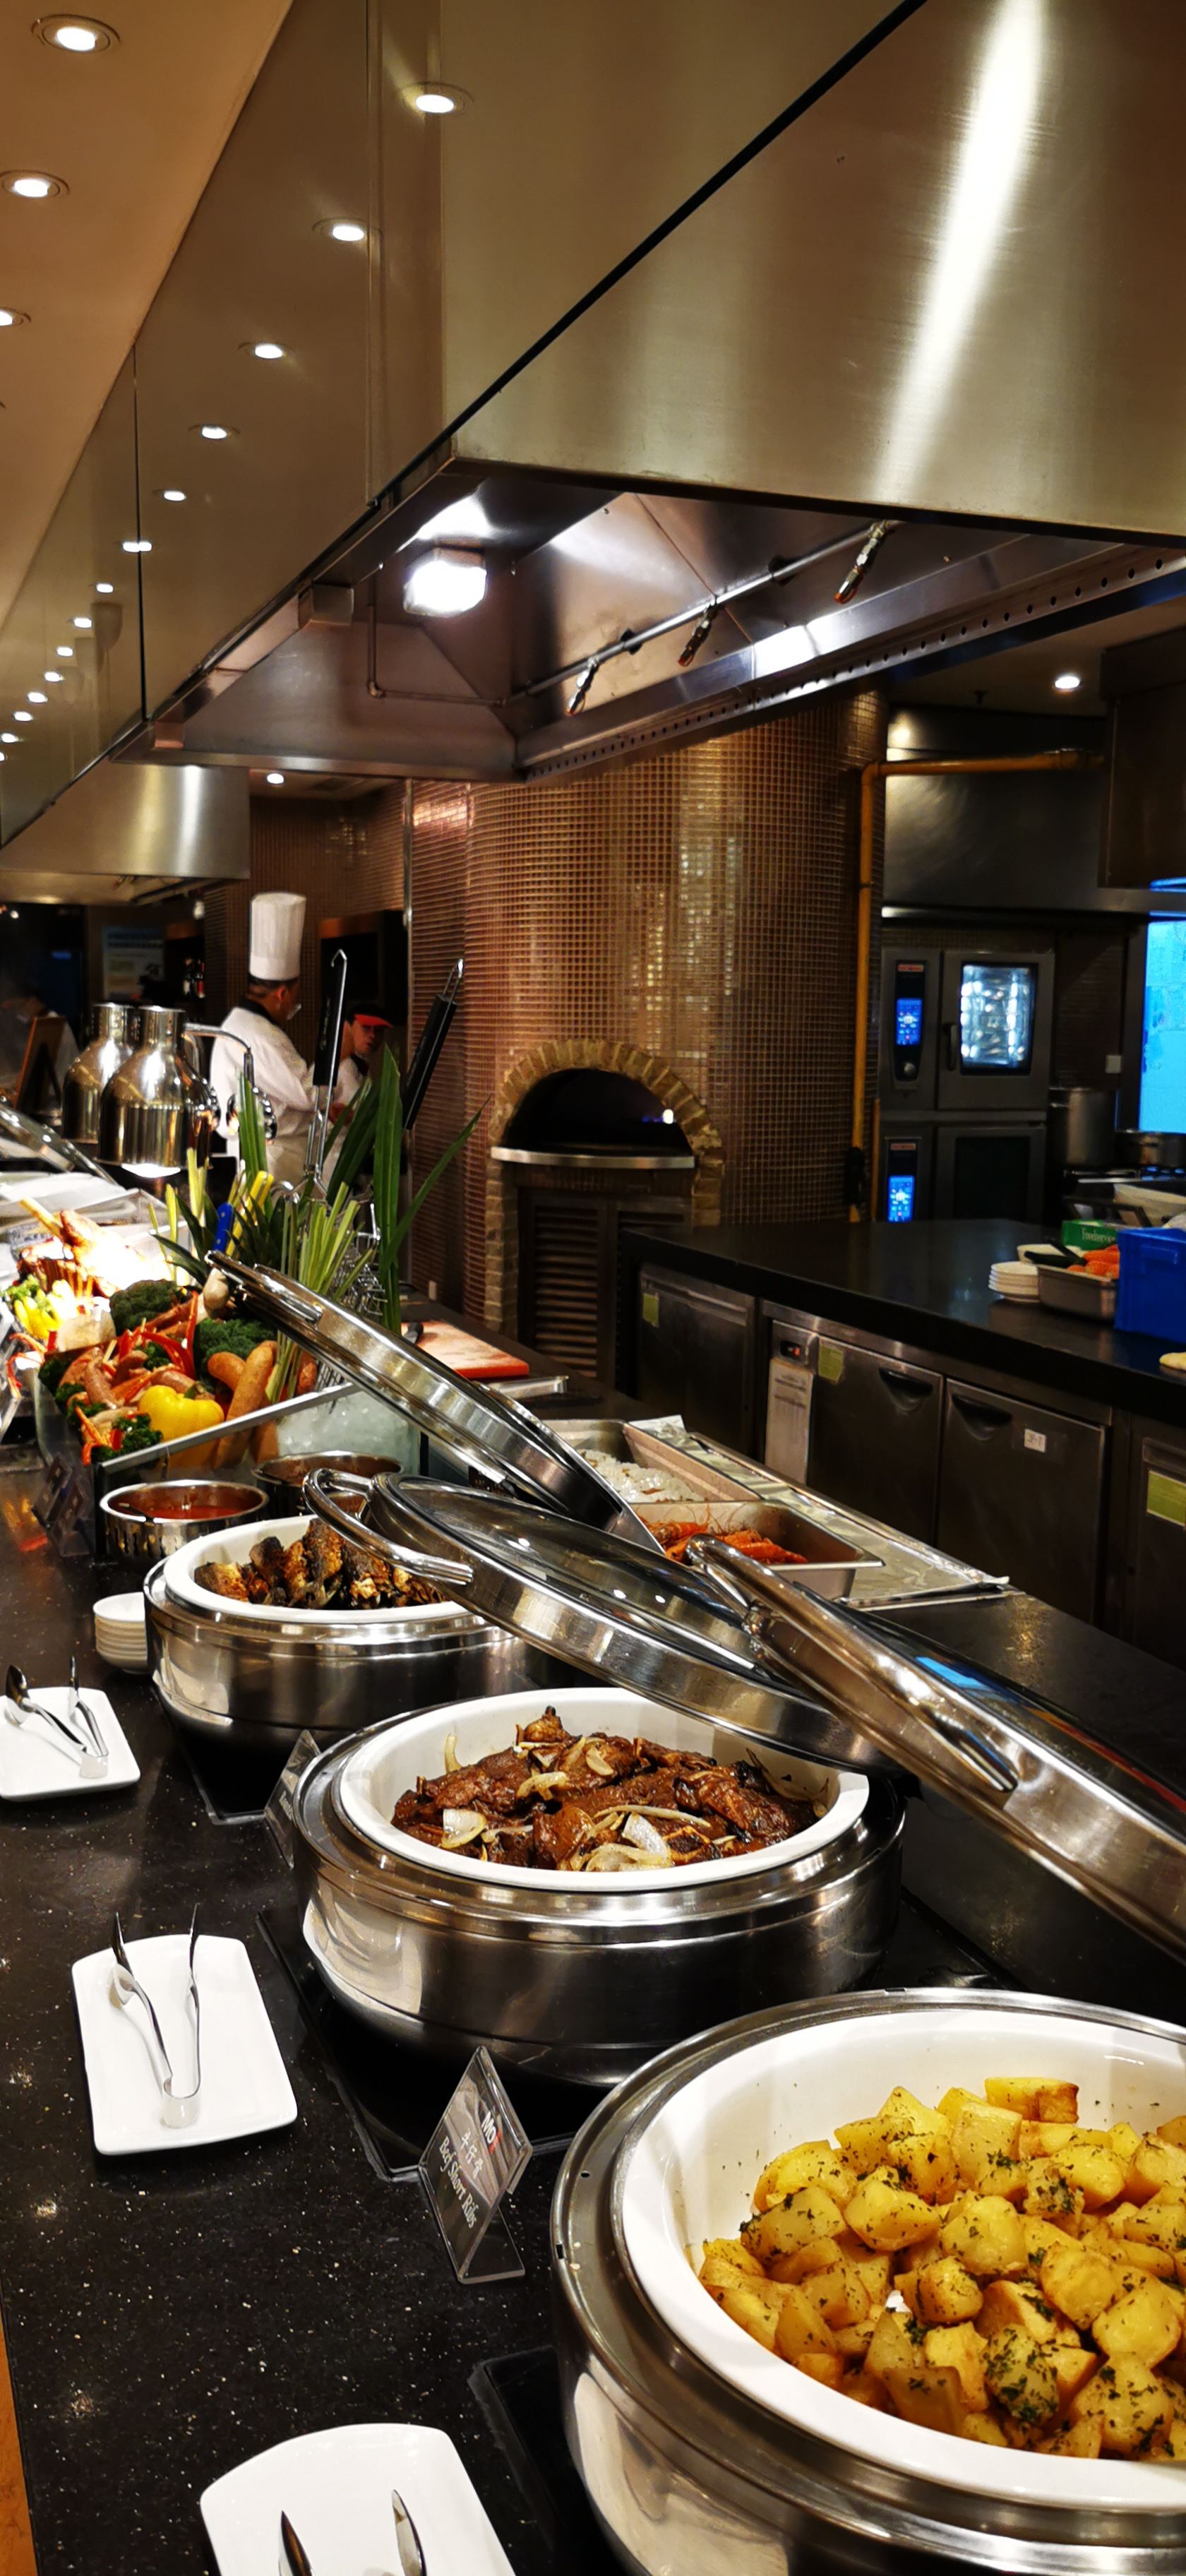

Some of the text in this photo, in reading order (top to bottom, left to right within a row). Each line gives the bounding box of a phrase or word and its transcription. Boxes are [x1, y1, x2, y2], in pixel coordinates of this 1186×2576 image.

[439, 2135, 479, 2229] Beef Short Ribs
[460, 2129, 483, 2178] 牛仔骨
